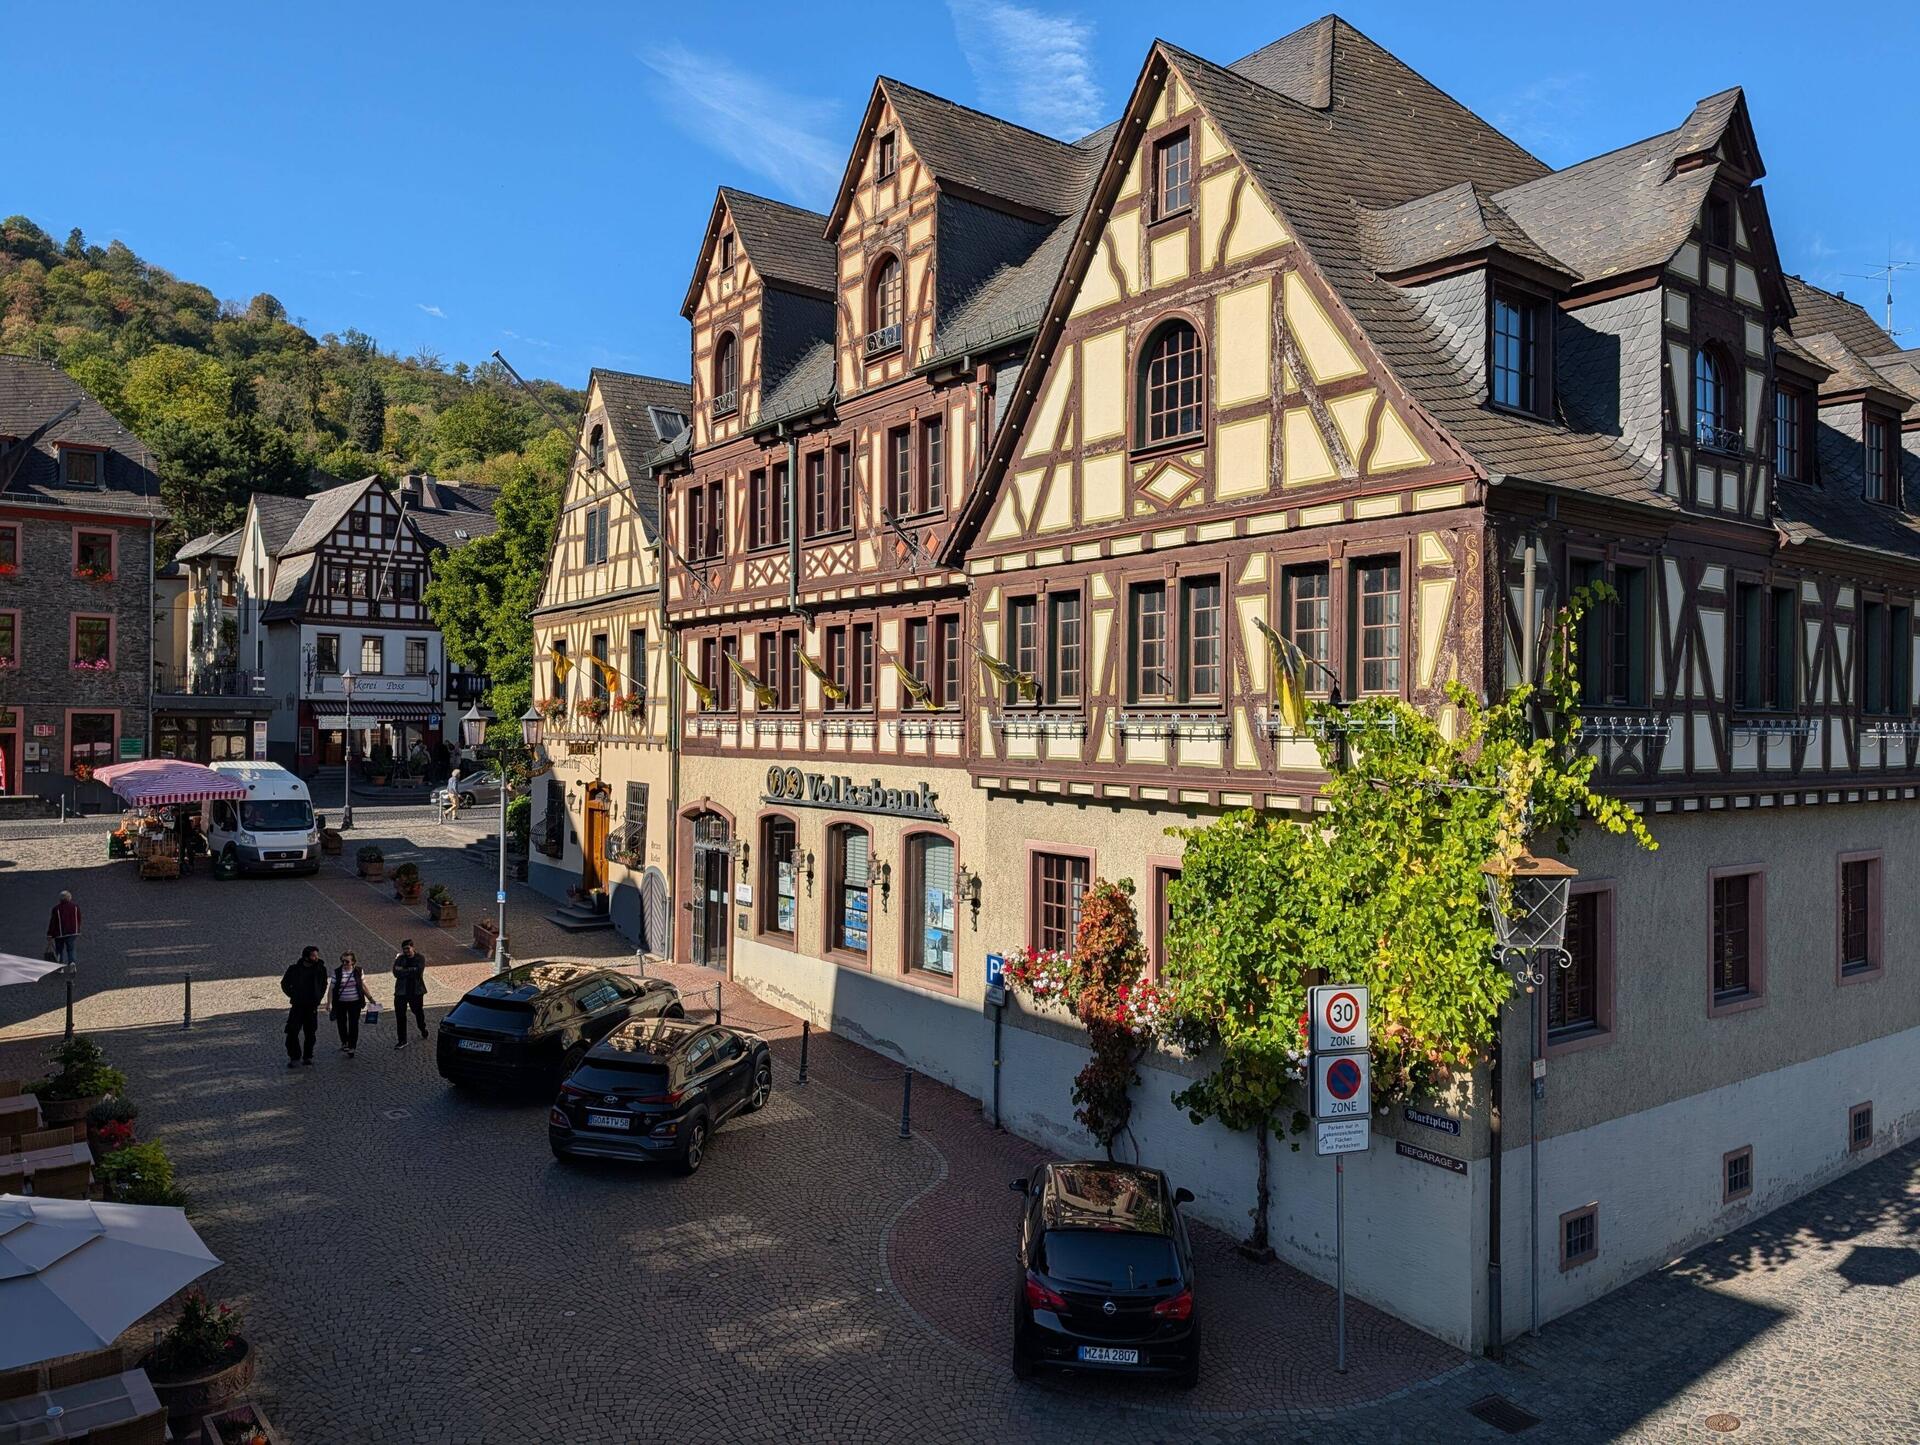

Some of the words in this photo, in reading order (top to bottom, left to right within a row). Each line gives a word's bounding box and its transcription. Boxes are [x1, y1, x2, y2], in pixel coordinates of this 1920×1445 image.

[570, 743, 595, 754] HOTEL
[804, 773, 939, 814] Volksbank
[990, 958, 1000, 981] P
[1333, 1004, 1353, 1022] 30
[1330, 1035, 1356, 1047] ZONE
[1331, 1101, 1357, 1114] ZONE
[1407, 1110, 1454, 1133] Marktplatz
[1400, 1145, 1453, 1168] TIEFGARAGE
[1085, 1348, 1097, 1359] MZ
[1112, 1350, 1136, 1361] 2807
